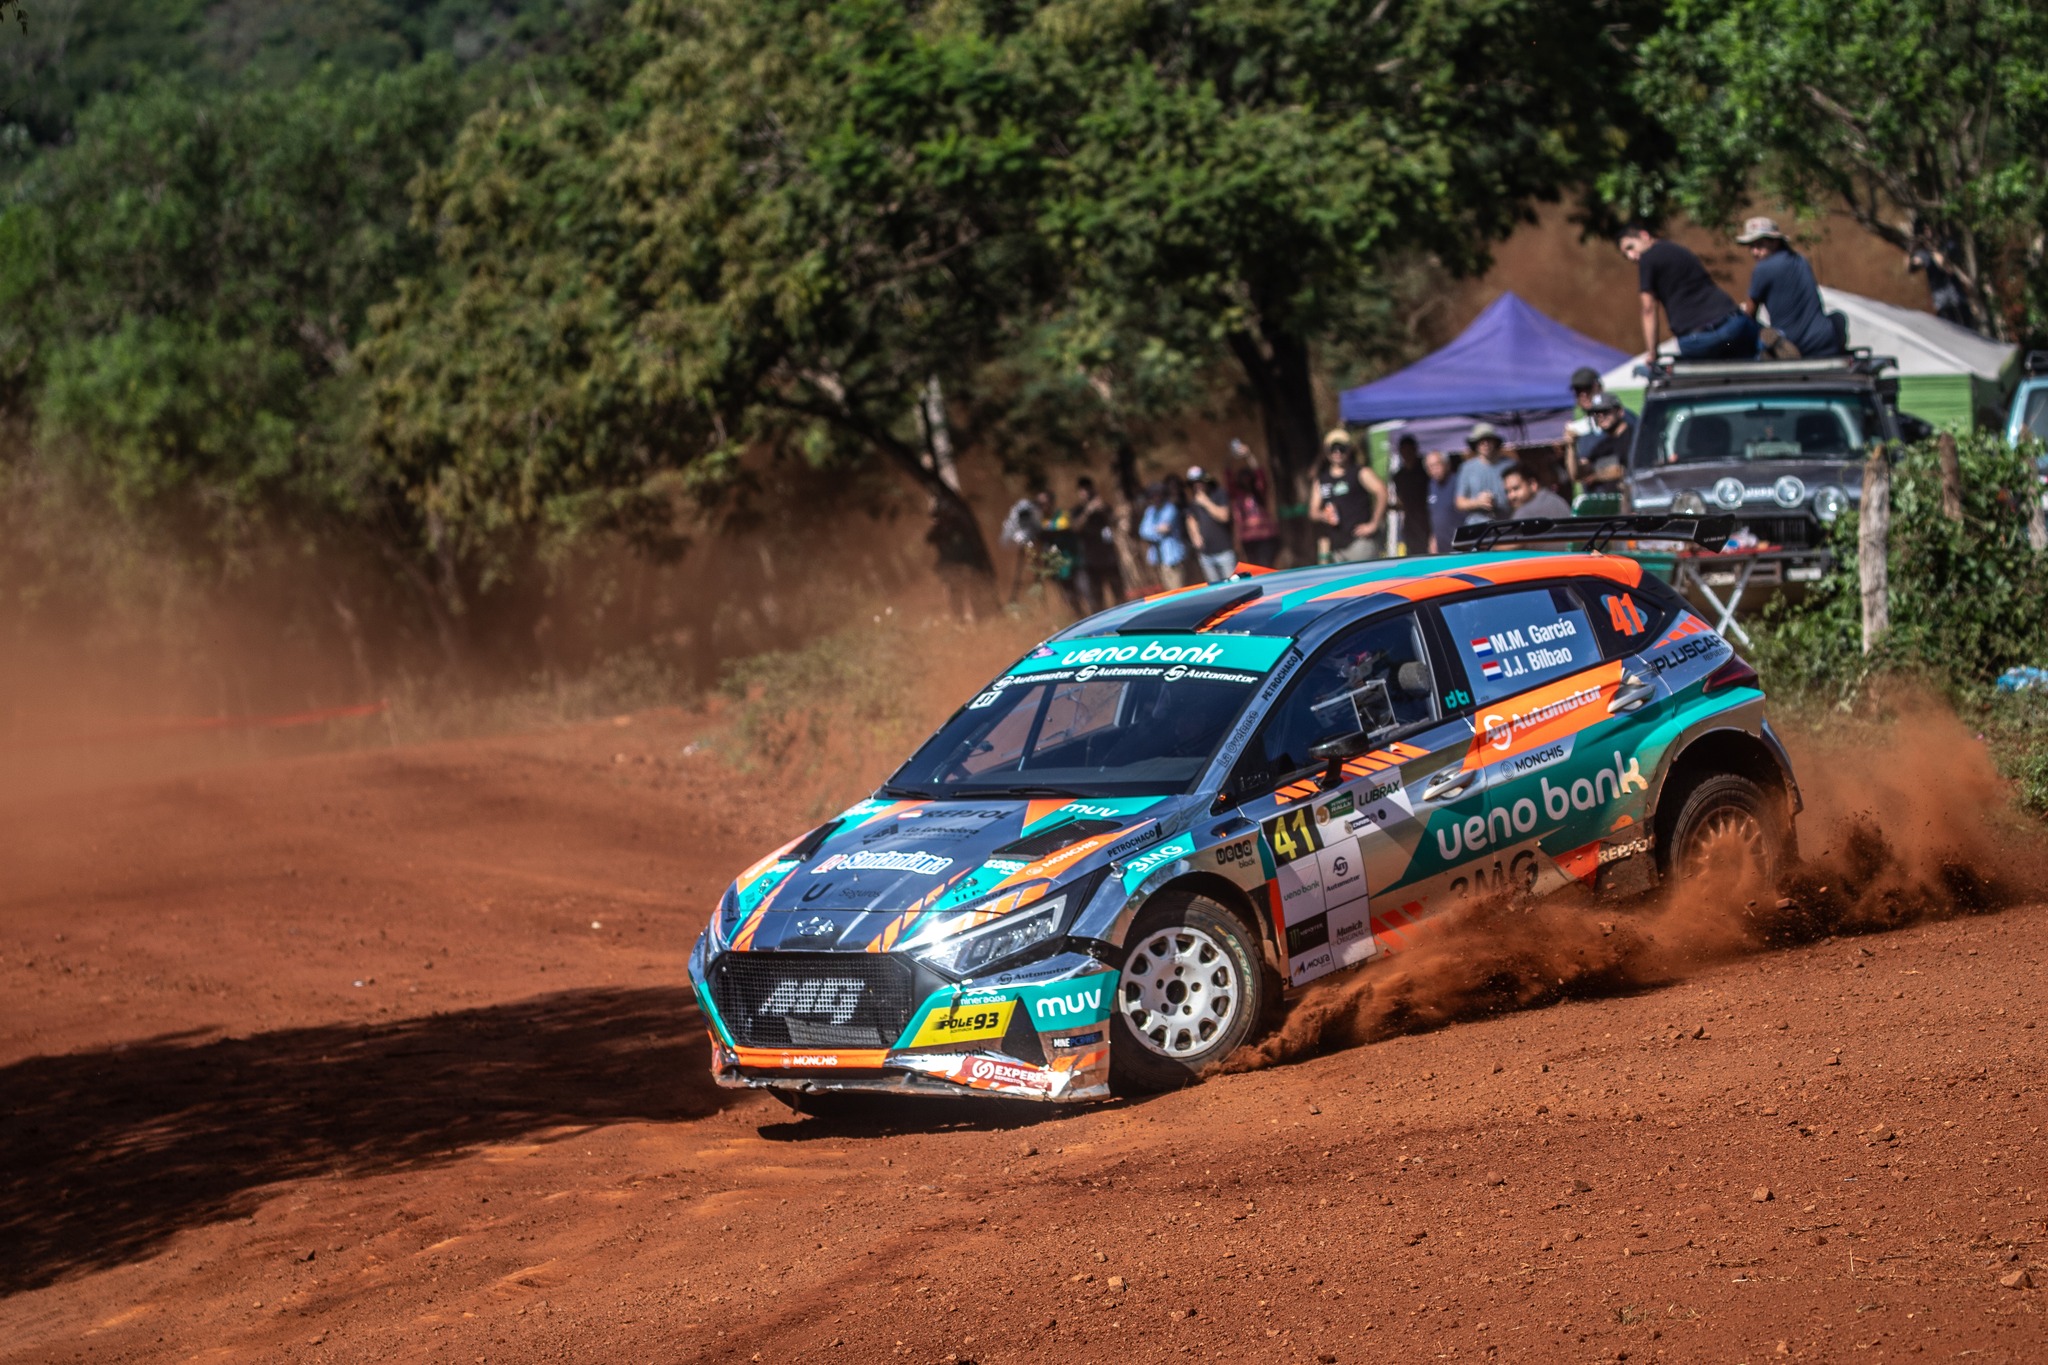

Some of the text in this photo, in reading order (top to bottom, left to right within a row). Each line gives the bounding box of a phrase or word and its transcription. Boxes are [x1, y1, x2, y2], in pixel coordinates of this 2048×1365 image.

[1606, 592, 1646, 637] 41
[1489, 617, 1576, 655] M.M. García
[1140, 641, 1224, 664] bank
[1502, 646, 1573, 678] J.J. Bilbao
[1012, 669, 1075, 685] Automotor
[1095, 666, 1164, 678] Automotor
[1185, 669, 1258, 684] Automotor
[1262, 655, 1299, 702] PETROCHACO
[1511, 684, 1603, 732] Automotor
[1217, 710, 1260, 769] La Ovetense
[1514, 745, 1565, 773] MONCHIS
[1358, 780, 1400, 806] LUBRAX
[1436, 750, 1649, 861] ueno bank
[1060, 803, 1120, 818] muv
[1106, 830, 1156, 858] PETROCHACO
[1274, 808, 1316, 861] 41
[1042, 839, 1100, 868] MONCHIS
[1127, 845, 1183, 873] 3MG
[1301, 879, 1320, 895] bank
[1326, 874, 1361, 892] Automotor
[1336, 920, 1363, 937] Munich
[1013, 965, 1073, 980] Automotor
[1036, 988, 1102, 1018] muv
[939, 1017, 974, 1030] POLE
[973, 1011, 999, 1031] 93
[793, 1055, 838, 1067] MONCHIS
